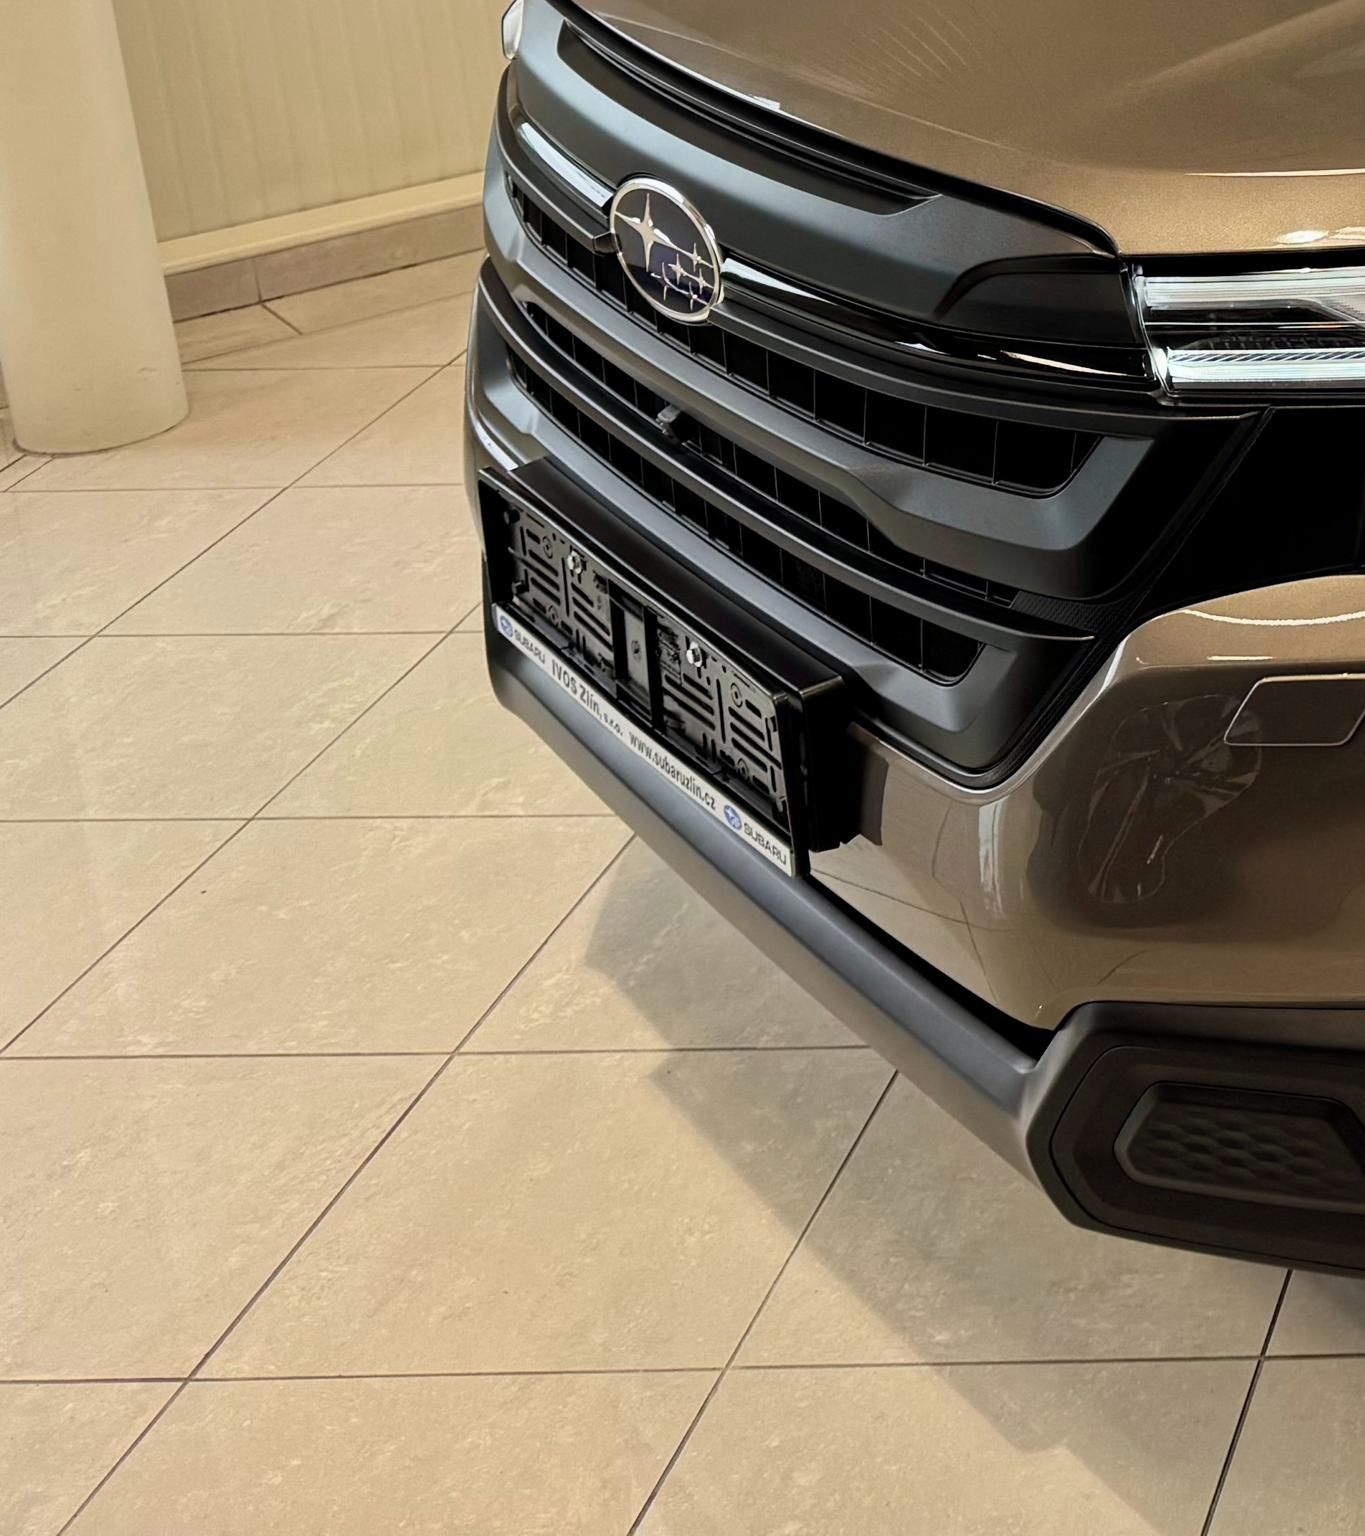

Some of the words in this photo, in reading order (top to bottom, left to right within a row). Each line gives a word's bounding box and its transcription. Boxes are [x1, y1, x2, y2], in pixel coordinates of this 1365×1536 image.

[514, 627, 546, 665] SUBARU
[551, 657, 578, 696] IVOS
[628, 730, 717, 811] www.subaruzlin.cz
[743, 821, 787, 865] SUBARU
